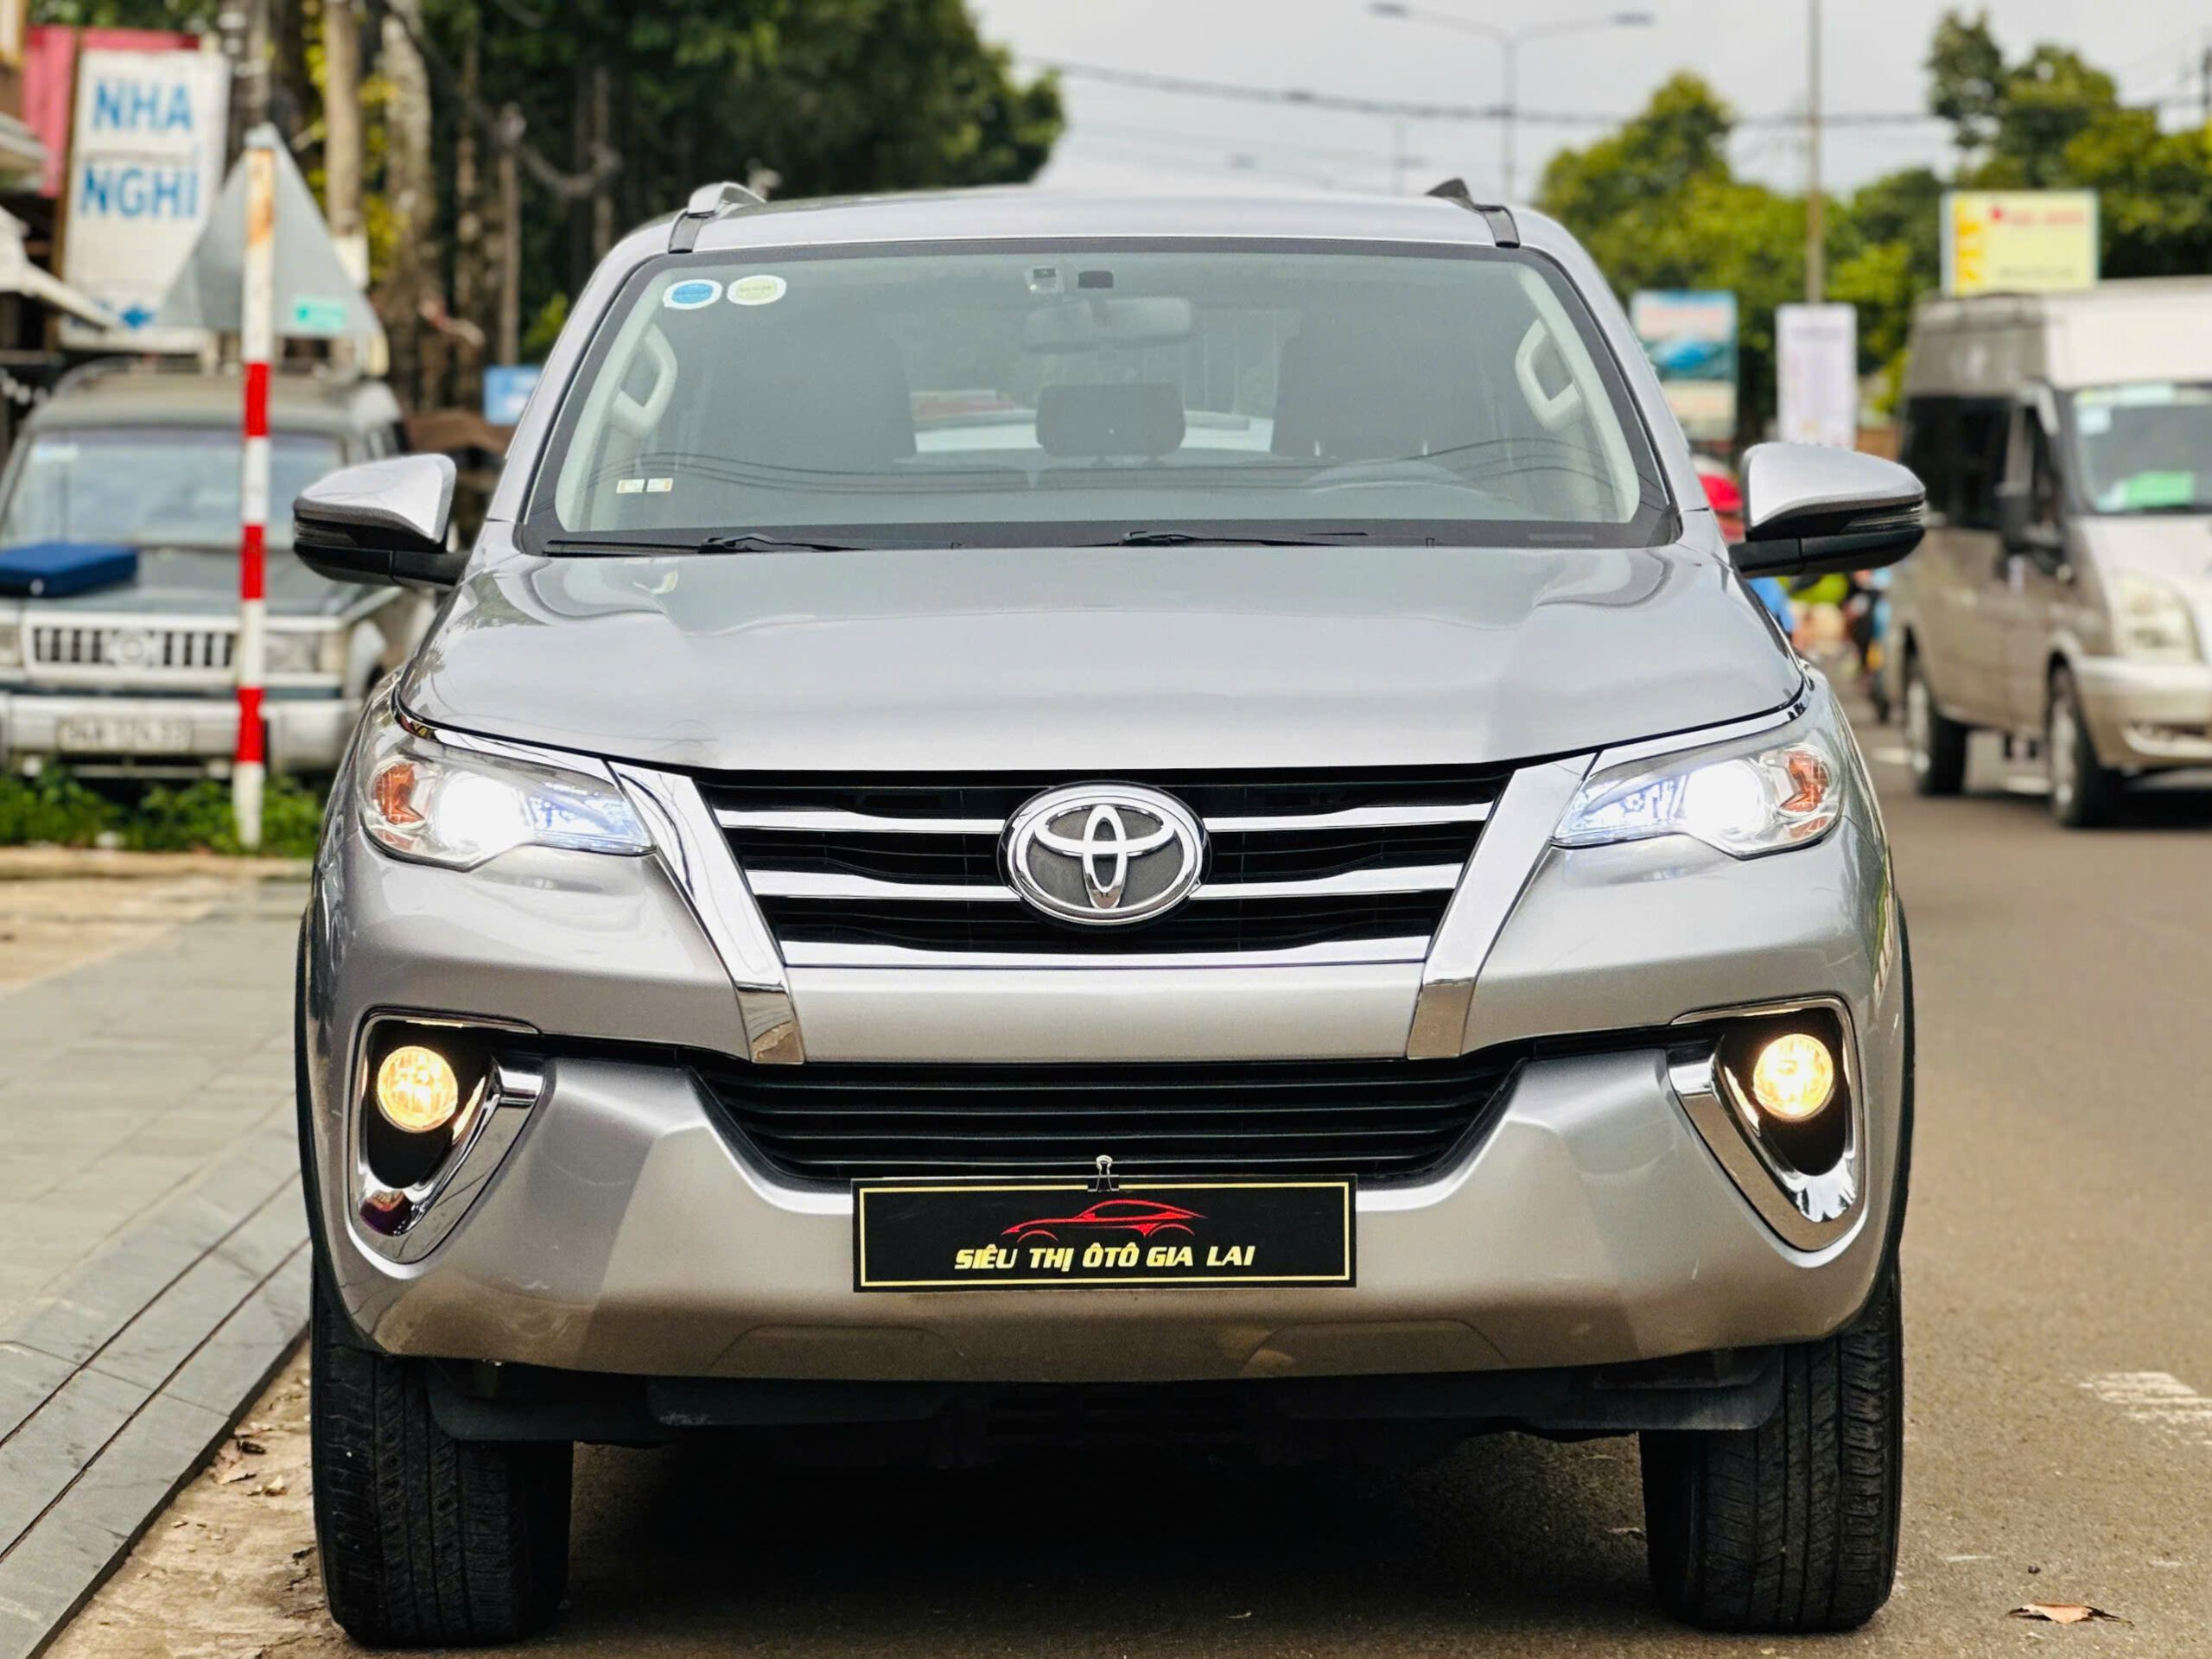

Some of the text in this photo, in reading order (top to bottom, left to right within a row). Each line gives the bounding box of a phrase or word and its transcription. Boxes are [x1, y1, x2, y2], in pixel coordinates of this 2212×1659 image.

[954, 1242, 1255, 1272] SIÊU THỊ ÔTÔ GIA LAI
